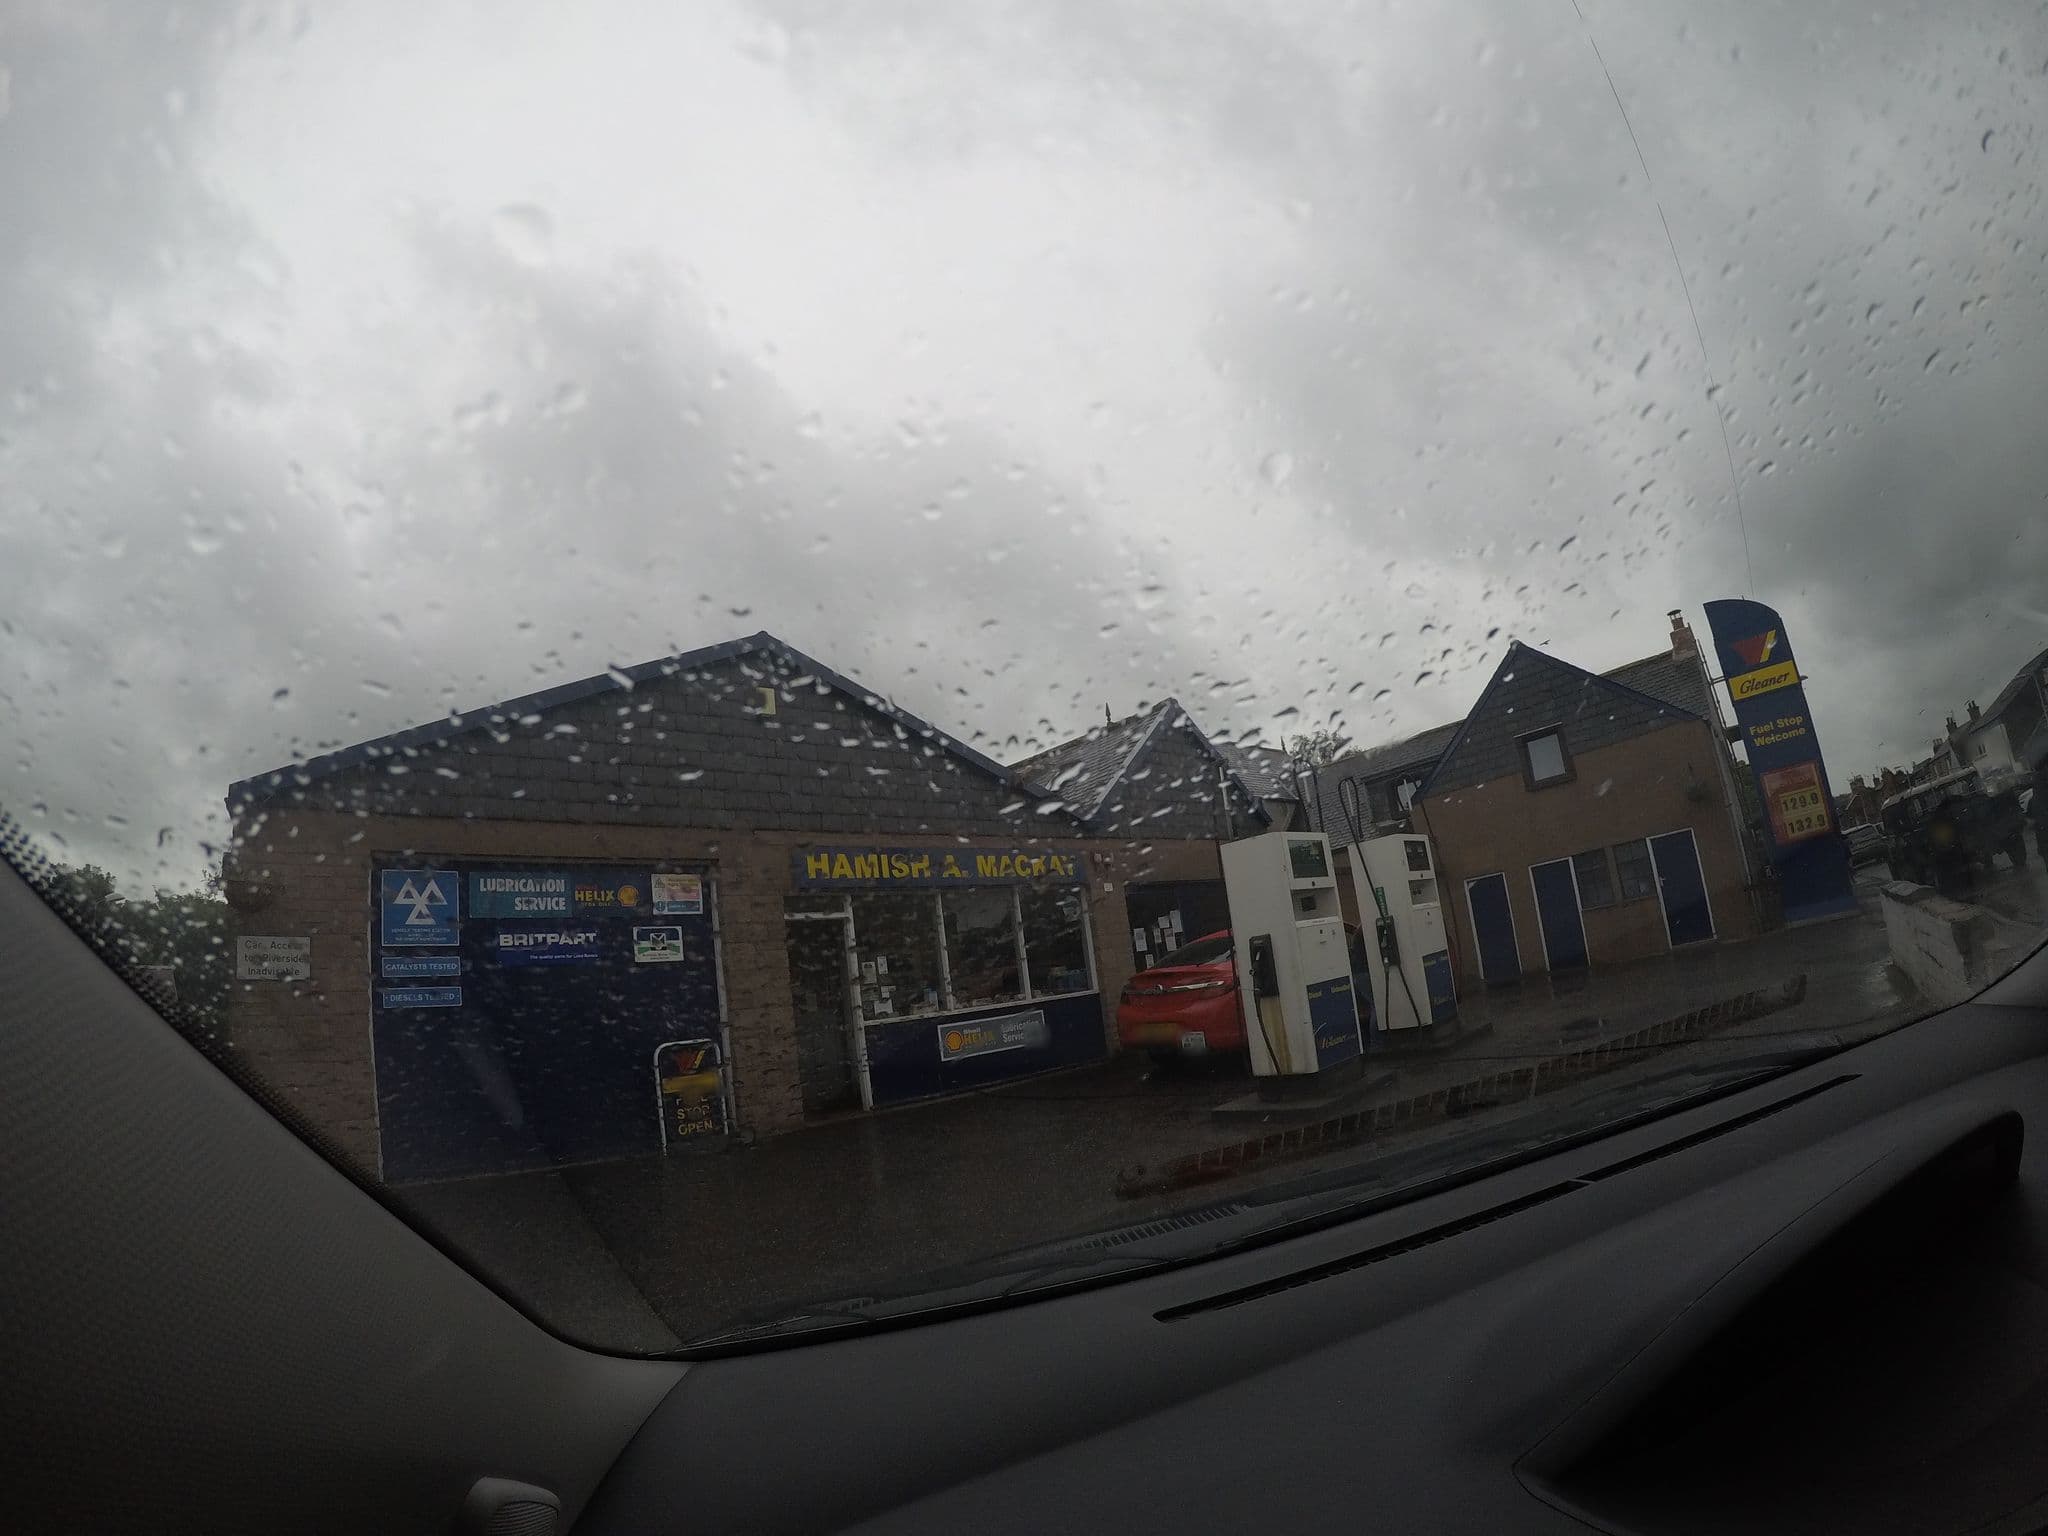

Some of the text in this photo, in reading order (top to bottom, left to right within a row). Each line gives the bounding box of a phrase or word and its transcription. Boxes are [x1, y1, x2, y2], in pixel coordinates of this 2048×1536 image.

[1738, 672, 1790, 694] Gleaner
[1750, 715, 1804, 736] Fuel Stop
[1753, 727, 1806, 747] Welcome
[806, 853, 931, 879] HAMISH
[976, 854, 1075, 878] MACKAY
[479, 878, 566, 893] LUBRICATION
[574, 889, 615, 902] HELIX
[514, 897, 567, 911] SERVICE
[245, 940, 304, 951] Car Acce
[499, 931, 598, 947] BRITPART
[385, 963, 458, 971] CATALYSTS TESTED
[1002, 1030, 1028, 1043] Servic
[678, 1119, 713, 1136] OPEN
